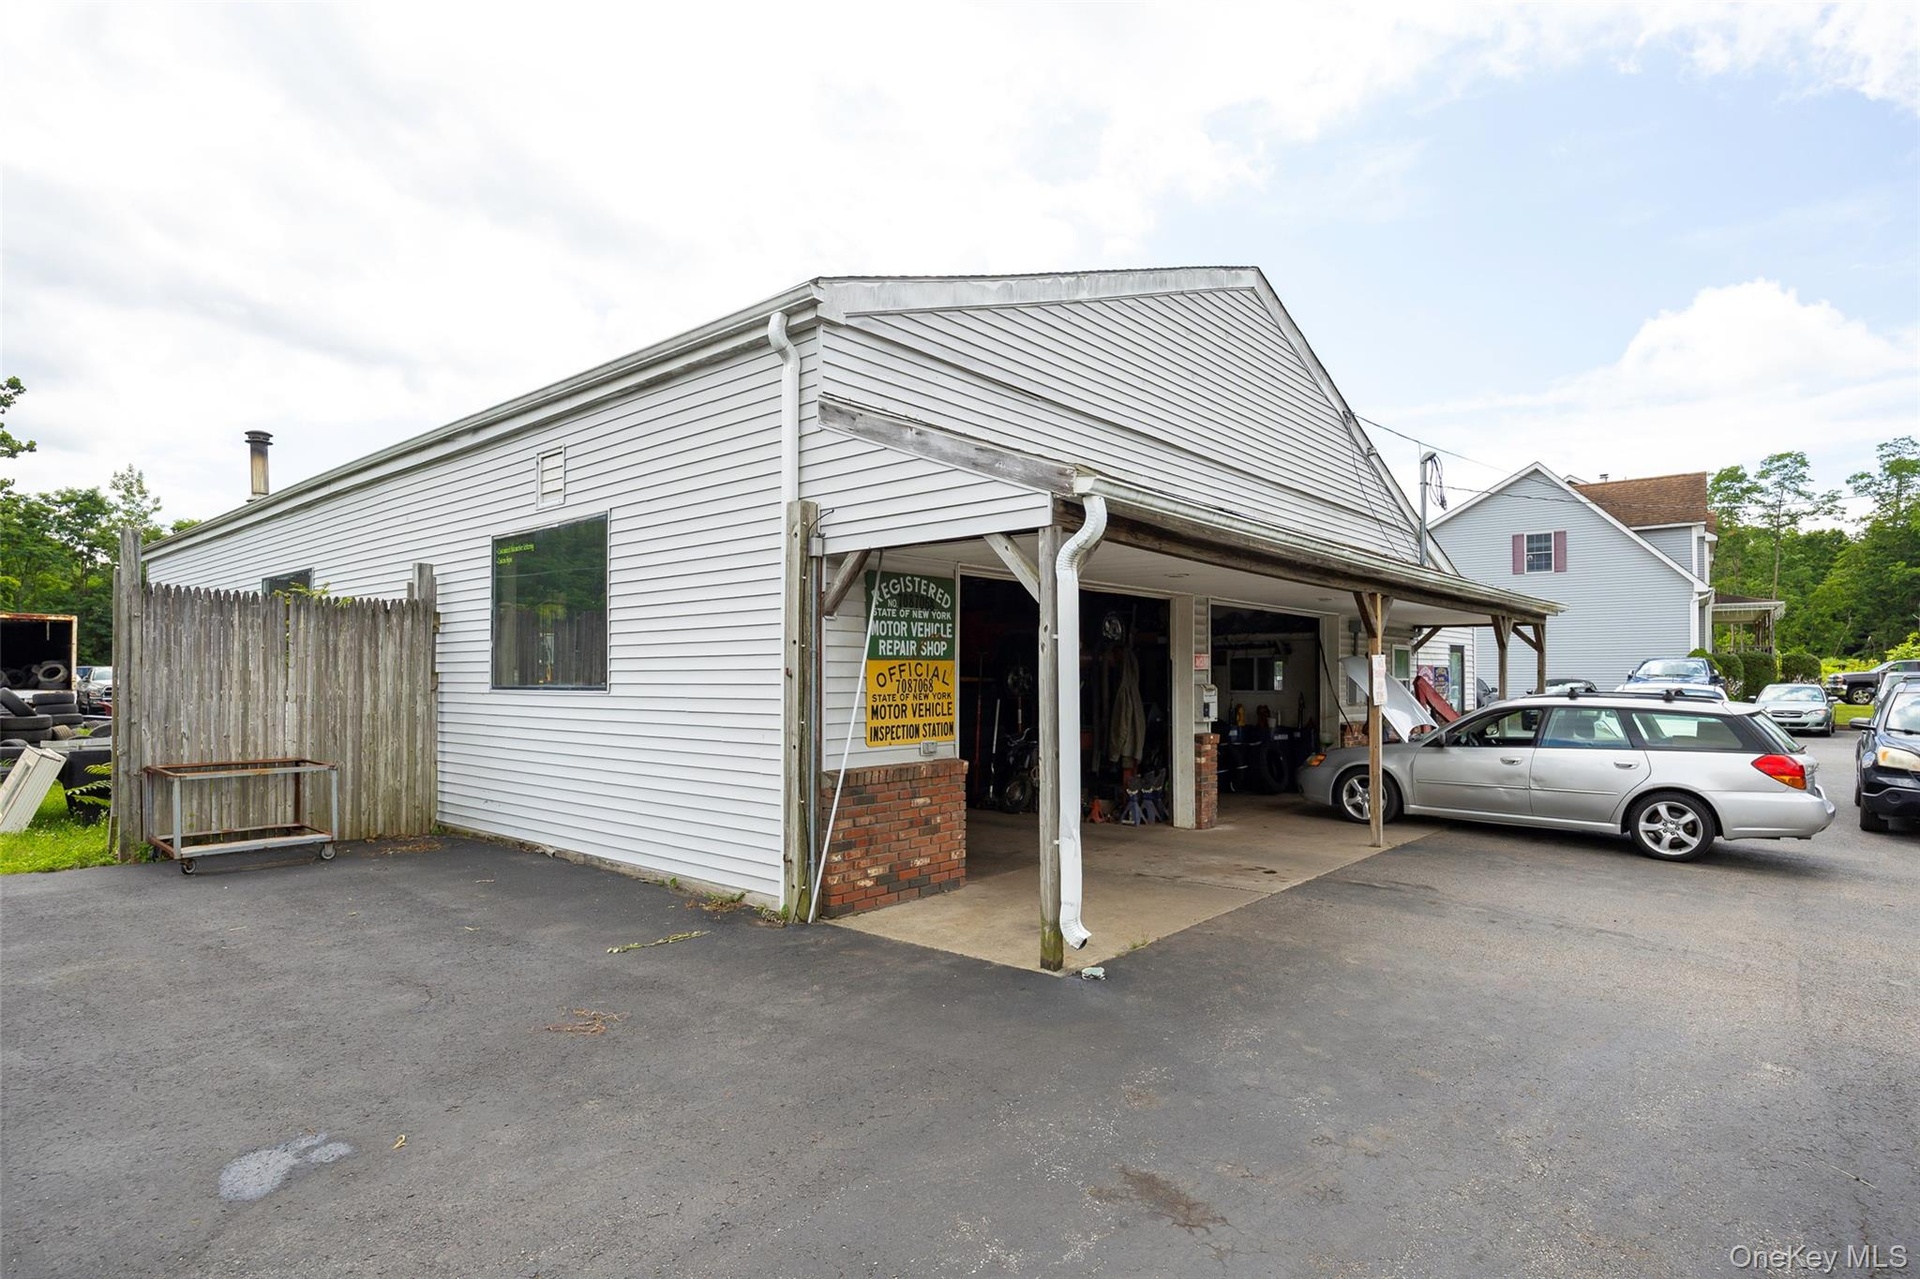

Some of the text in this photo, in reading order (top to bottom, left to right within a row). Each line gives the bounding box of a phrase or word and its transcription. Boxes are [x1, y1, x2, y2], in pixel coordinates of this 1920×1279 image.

[871, 576, 952, 608] REGISTERED
[872, 608, 952, 620] STATE OF NEW YORK
[870, 620, 953, 638] MOTOR VEHICLE
[879, 639, 948, 656] REPAIR SHOP
[876, 662, 950, 688] OFFICIAL
[896, 678, 934, 694] 7087068
[872, 692, 952, 702] STATE OF NEW YORK
[871, 701, 953, 720] MOTOR VEHICLE
[870, 721, 954, 742] INSPECTION STATION
